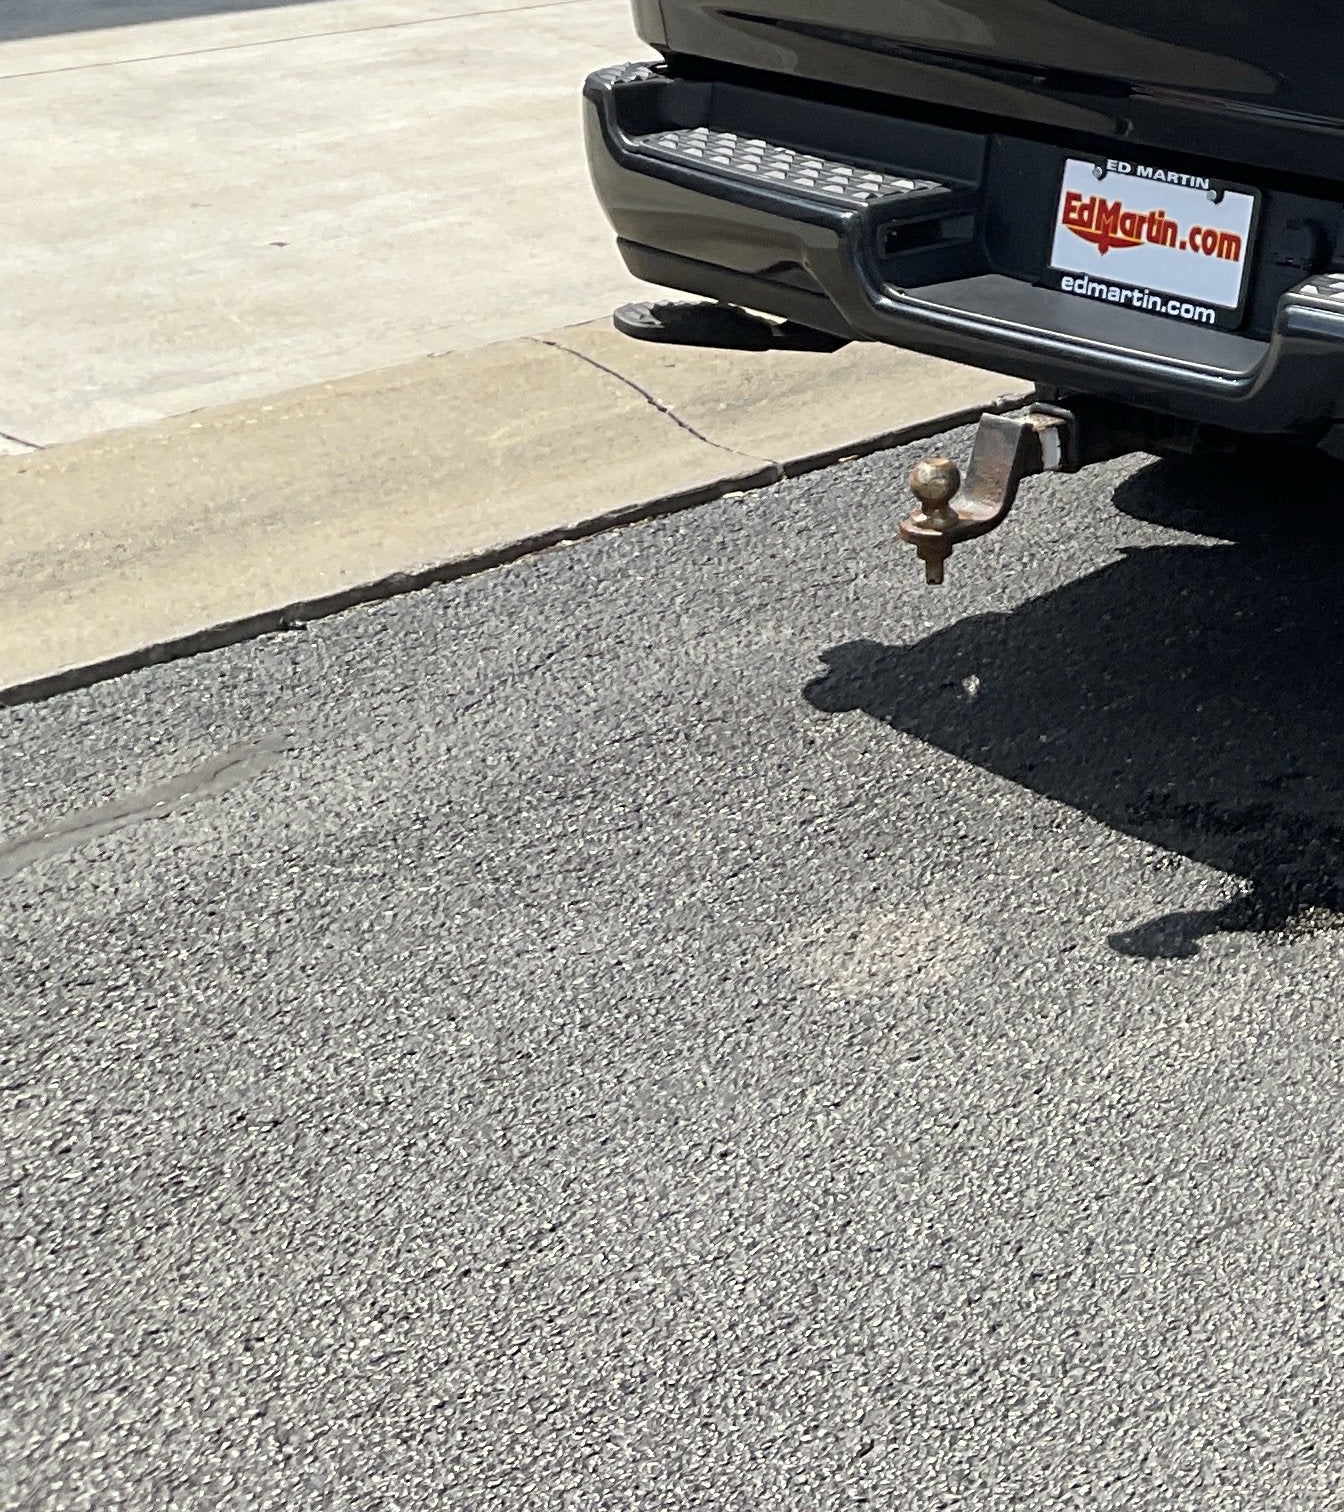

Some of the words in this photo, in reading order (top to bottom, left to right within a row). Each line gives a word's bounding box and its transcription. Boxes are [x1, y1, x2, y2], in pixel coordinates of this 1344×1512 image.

[1106, 159, 1132, 175] ED
[1136, 164, 1210, 190] MARTIN
[1061, 275, 1216, 324] edmartin.com
